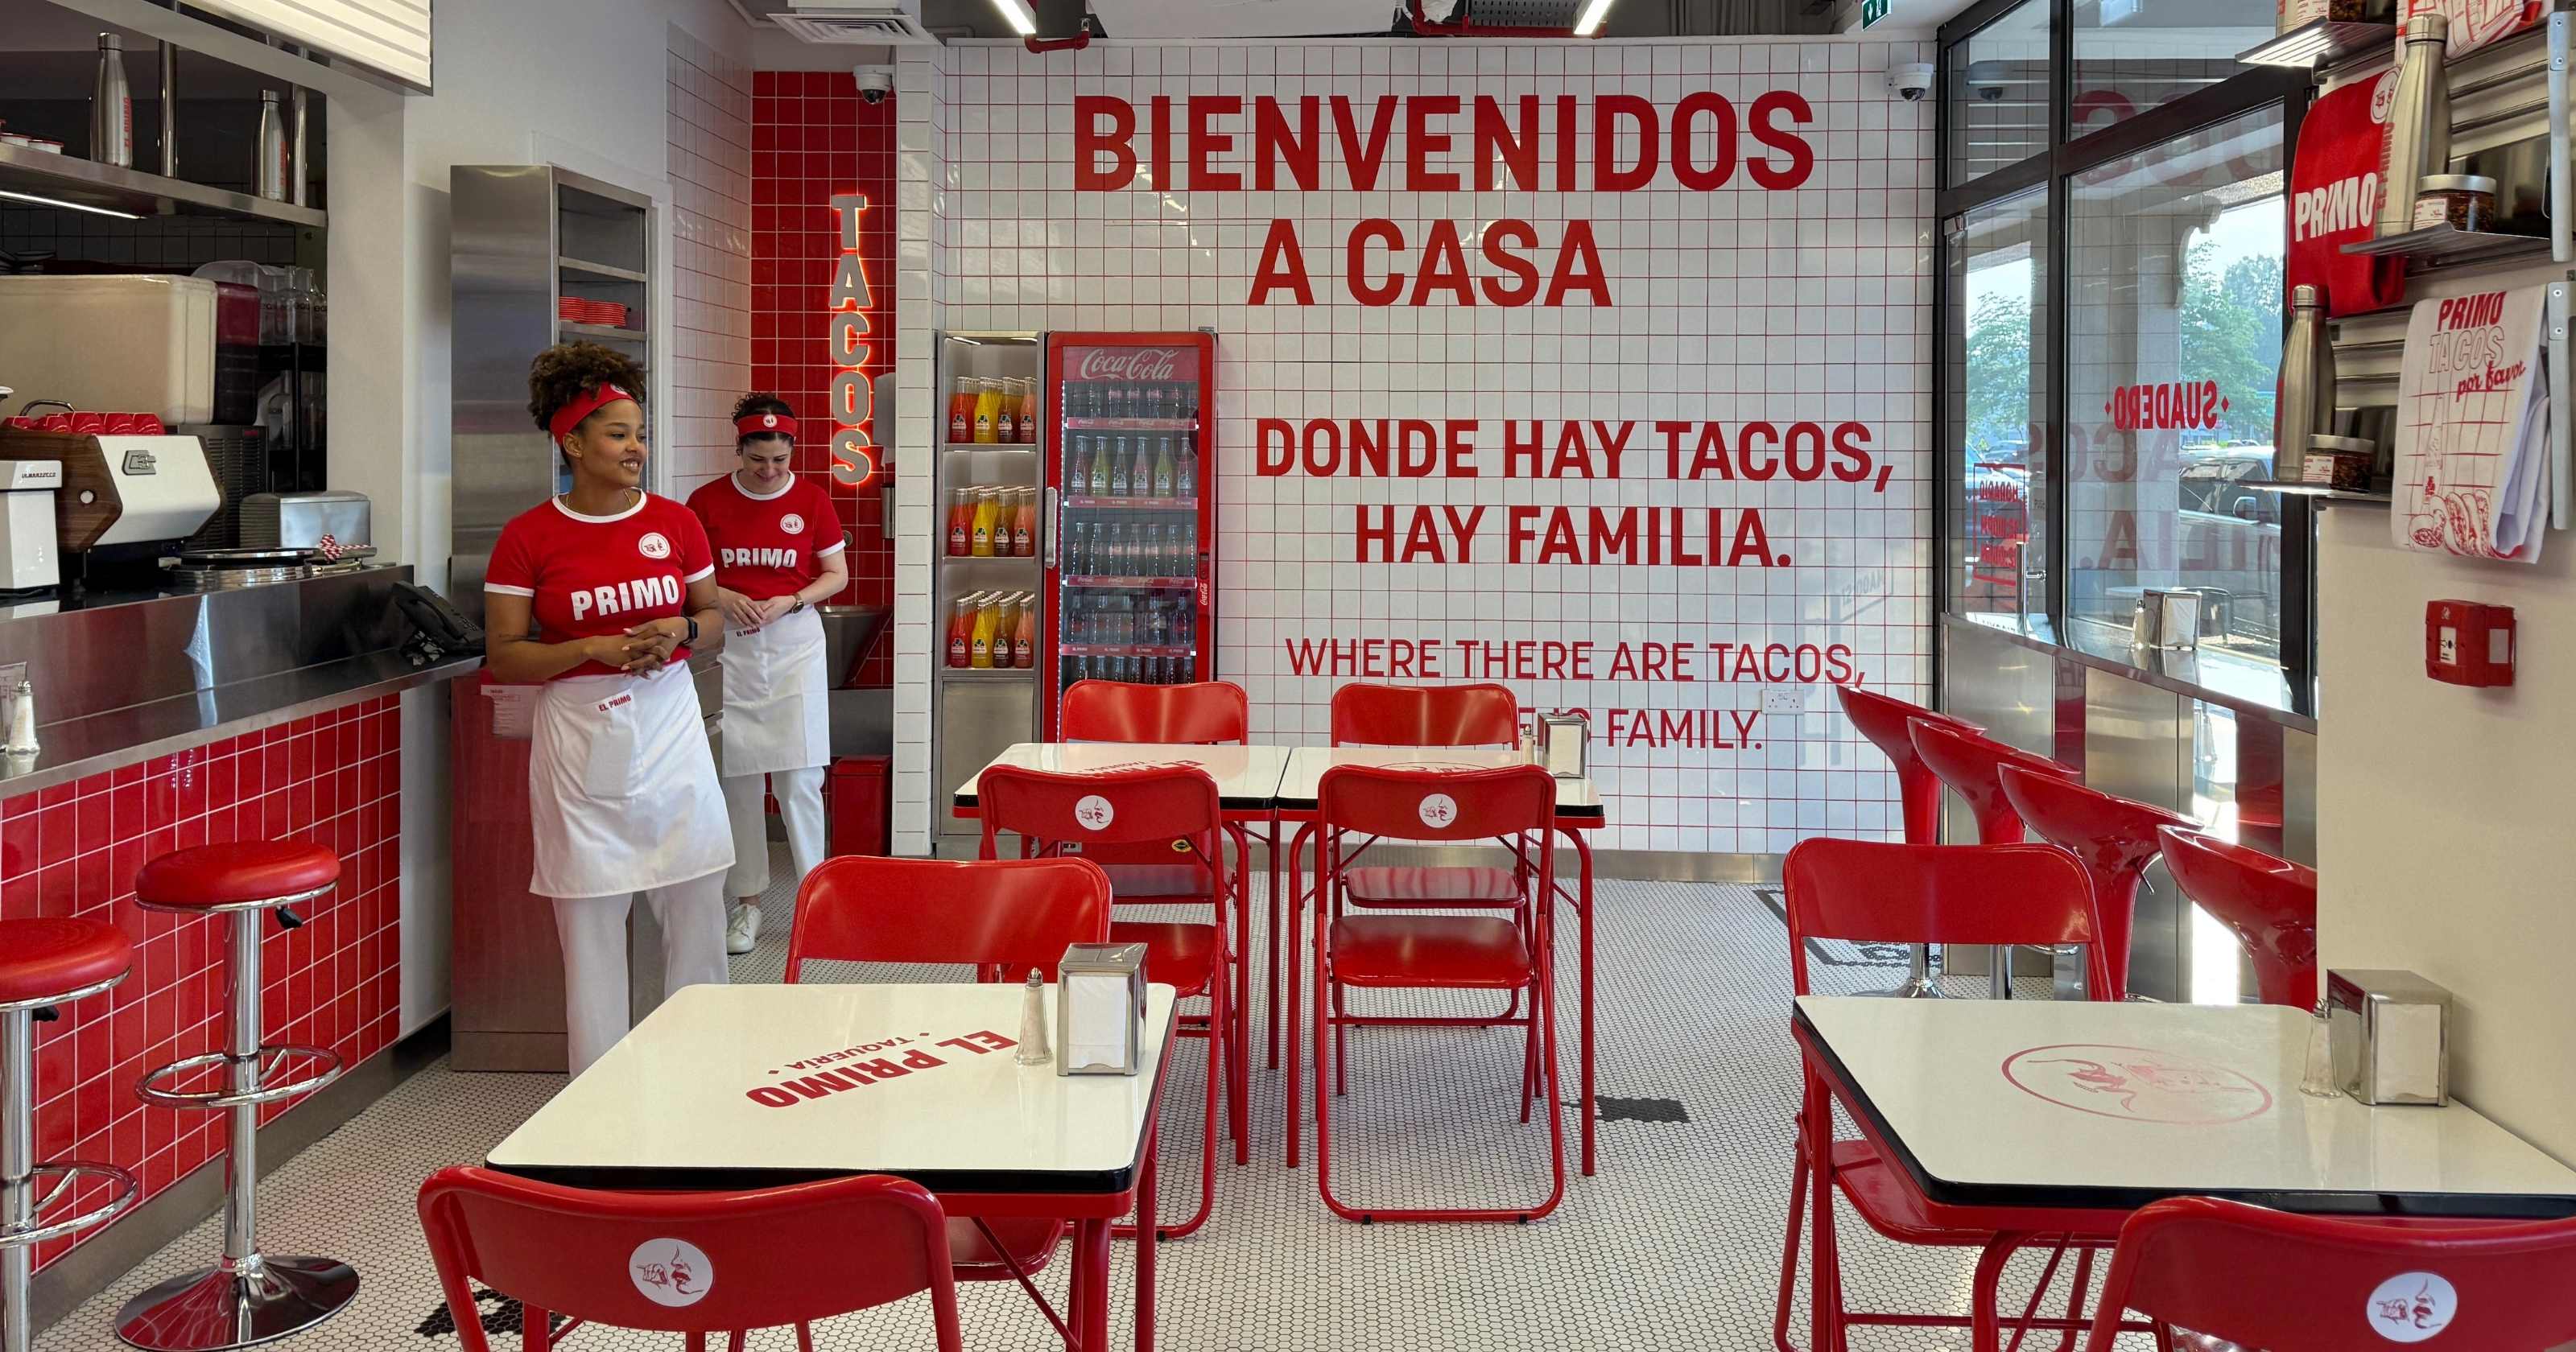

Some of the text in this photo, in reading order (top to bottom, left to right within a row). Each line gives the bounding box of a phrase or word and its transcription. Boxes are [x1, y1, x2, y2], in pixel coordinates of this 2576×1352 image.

[1075, 91, 1813, 192] BIENVENIDOS
[2295, 173, 2377, 241] PRIMO
[1248, 218, 1612, 307] A CASA
[2438, 291, 2507, 332] PRIMO
[830, 193, 872, 484] TACOS
[2429, 326, 2504, 373] TACOS
[1080, 348, 1179, 381] Coca-Cola
[2455, 373, 2483, 402] por
[1256, 418, 1893, 493] DONDE HAY TACOS,
[721, 547, 797, 569] PRIMO
[1356, 504, 1791, 567] HAY FAMILIA.
[571, 575, 679, 620] PRIMO
[1286, 638, 1865, 687] WHERE THERE ARE TACOS,
[609, 694, 632, 708] PRIMO
[1607, 708, 1763, 748] FAMILY.
[745, 1030, 1018, 1107] EL PRIMO
[784, 1036, 916, 1071] TAQUERÍA
